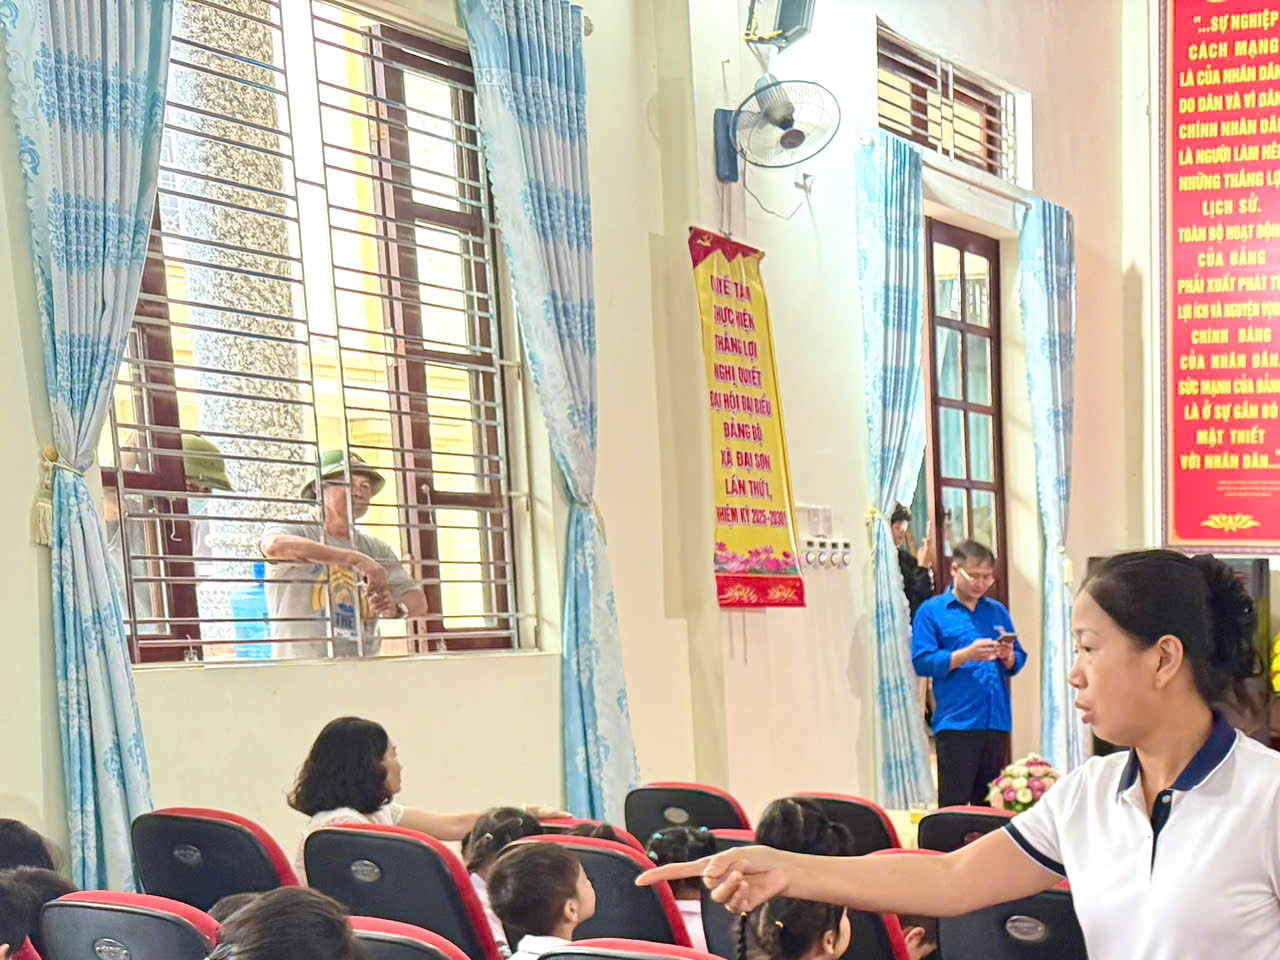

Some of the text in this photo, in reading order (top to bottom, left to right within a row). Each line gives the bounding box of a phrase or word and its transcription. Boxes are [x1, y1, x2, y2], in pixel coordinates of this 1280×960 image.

[1231, 8, 1279, 31] NGHIỆP
[1188, 38, 1279, 60] CÁCH MẠNG
[1180, 68, 1194, 88] LÀ
[1197, 64, 1220, 87] CỦA
[1223, 64, 1257, 84] NHÂN
[1179, 97, 1196, 113] DO
[1198, 93, 1223, 112] DÂN
[1225, 91, 1241, 110] VÀ
[1244, 89, 1256, 109] VÌ
[1179, 120, 1218, 139] CHÍNH
[1221, 116, 1257, 136] NHÂN
[1179, 147, 1194, 166] LÀ
[1196, 143, 1231, 164] NGƯỜI
[1234, 143, 1260, 162] LÀM
[1179, 172, 1221, 191] NHỮNG
[1202, 199, 1233, 218] LỊCH
[1178, 225, 1206, 243] TOÀN
[1208, 223, 1224, 244] BỘ
[1226, 224, 1254, 243] HOẠT
[1198, 244, 1266, 268] CỦA ĐẢNG
[1178, 272, 1204, 294] PHẢI
[1206, 273, 1236, 293] XUẤT
[1238, 273, 1267, 292] PHÁT
[1191, 326, 1229, 344] CHÍNH
[1180, 349, 1205, 370] CỦA
[1211, 350, 1247, 369] NHÂN
[714, 363, 736, 387] NGHỊ
[1233, 373, 1255, 394] CỦA
[723, 390, 740, 414] HỘI
[1184, 401, 1200, 420] LÀ
[724, 417, 763, 445] ĐẢNG BỘ
[1230, 425, 1265, 445] THIẾT
[720, 447, 771, 472] XÃ ĐẠI SƠN
[1180, 450, 1201, 470] VỚI
[1204, 451, 1239, 470] NHÂN
